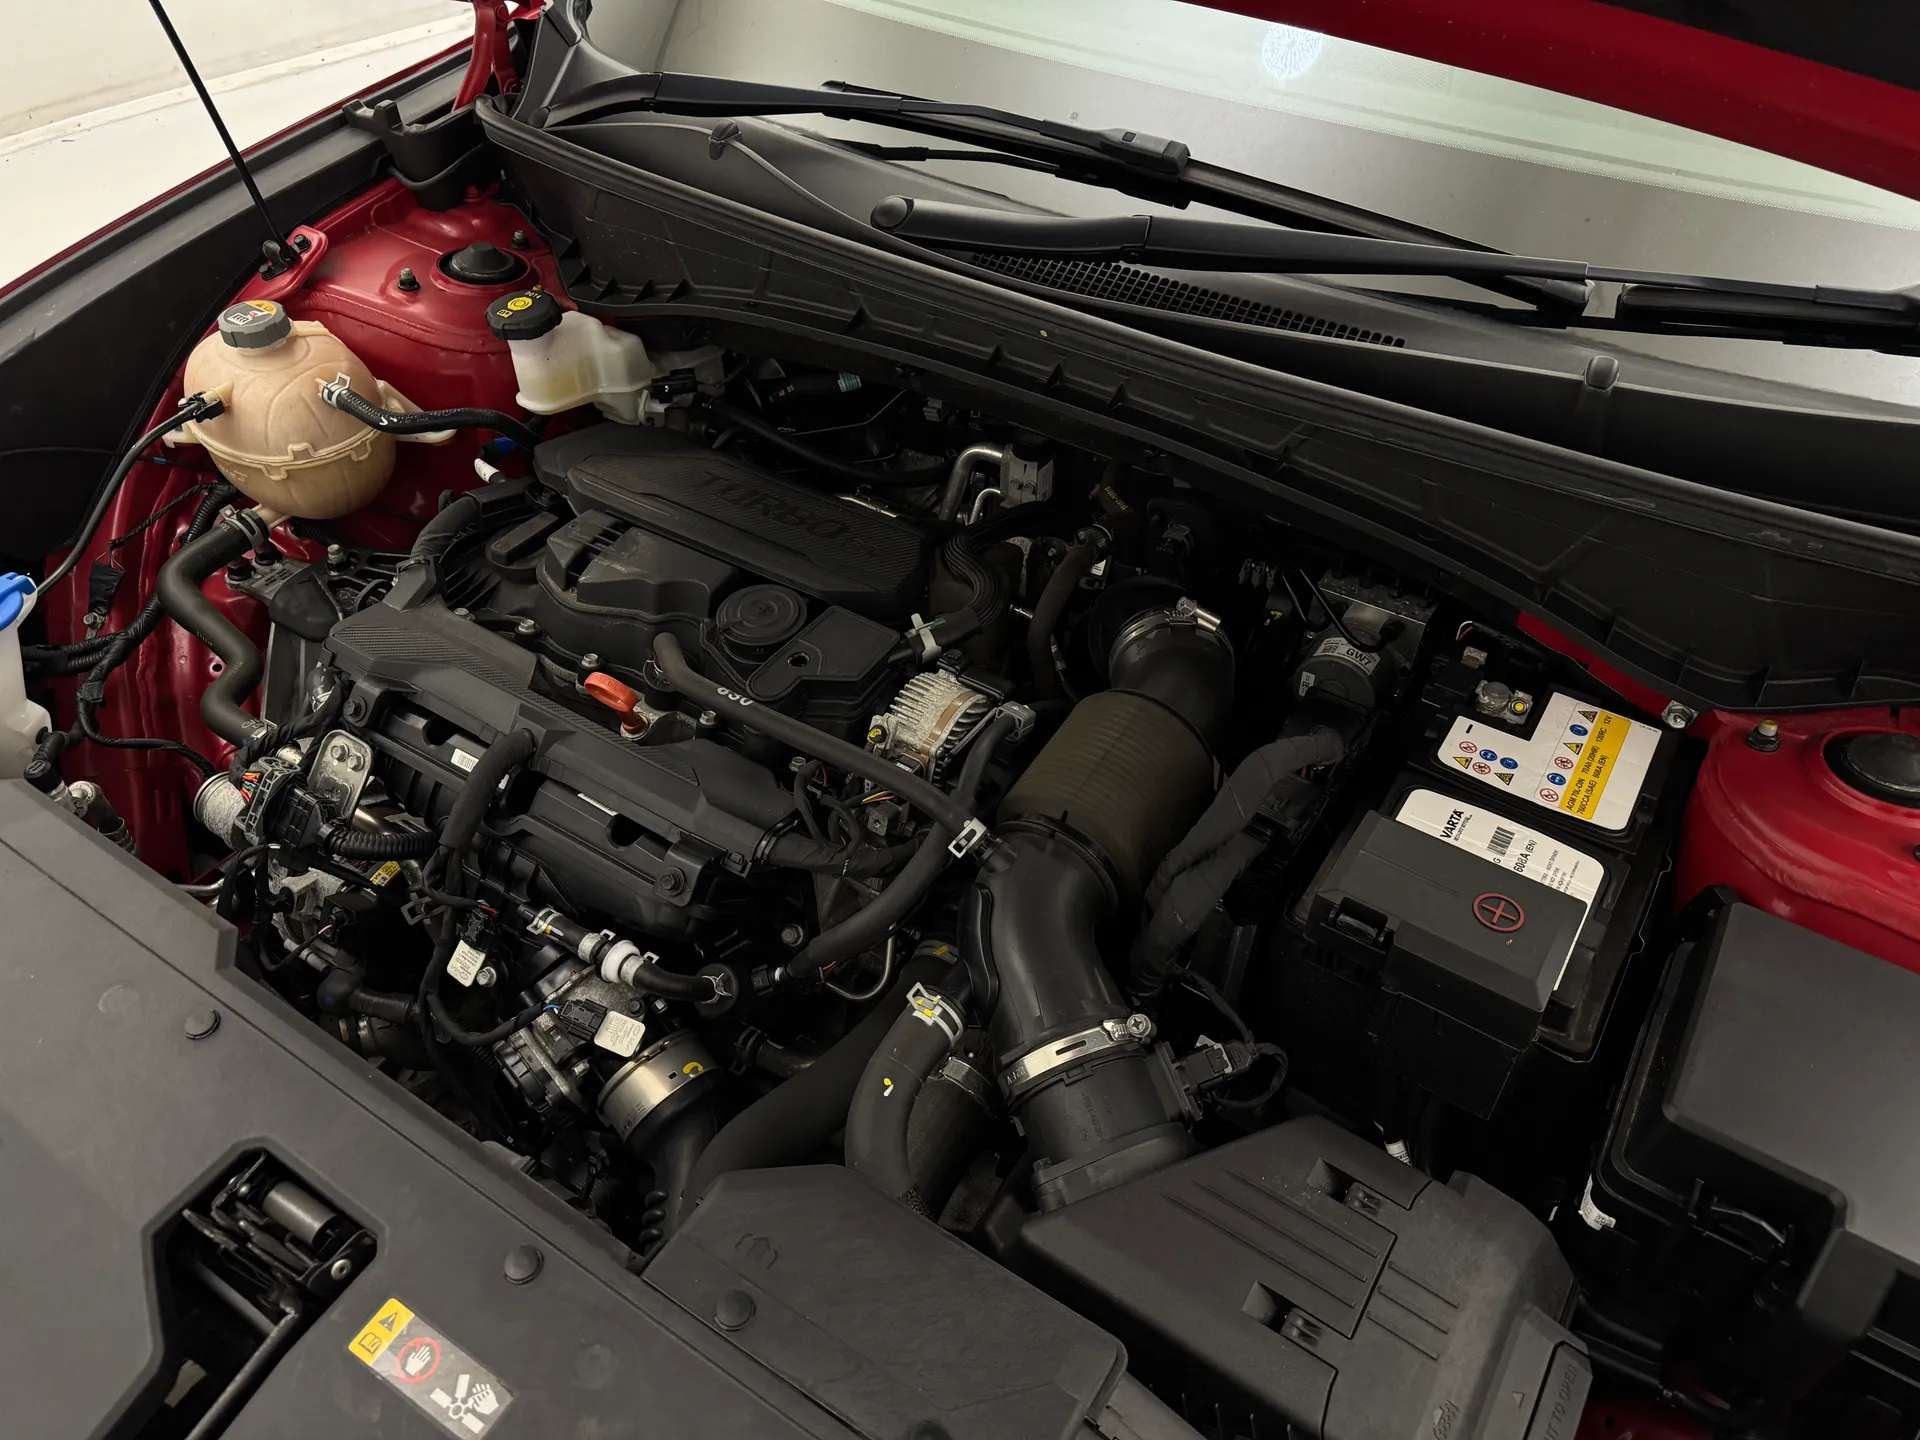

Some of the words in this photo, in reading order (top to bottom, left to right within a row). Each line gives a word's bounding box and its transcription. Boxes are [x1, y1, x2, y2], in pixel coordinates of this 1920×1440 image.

[693, 470, 849, 539] TURBO
[1347, 648, 1372, 666] GW7
[1440, 808, 1464, 839] VARTA
[1513, 852, 1531, 873] 608A
[1526, 839, 1538, 854] (EN)
[1559, 1363, 1577, 1401] OPEN
